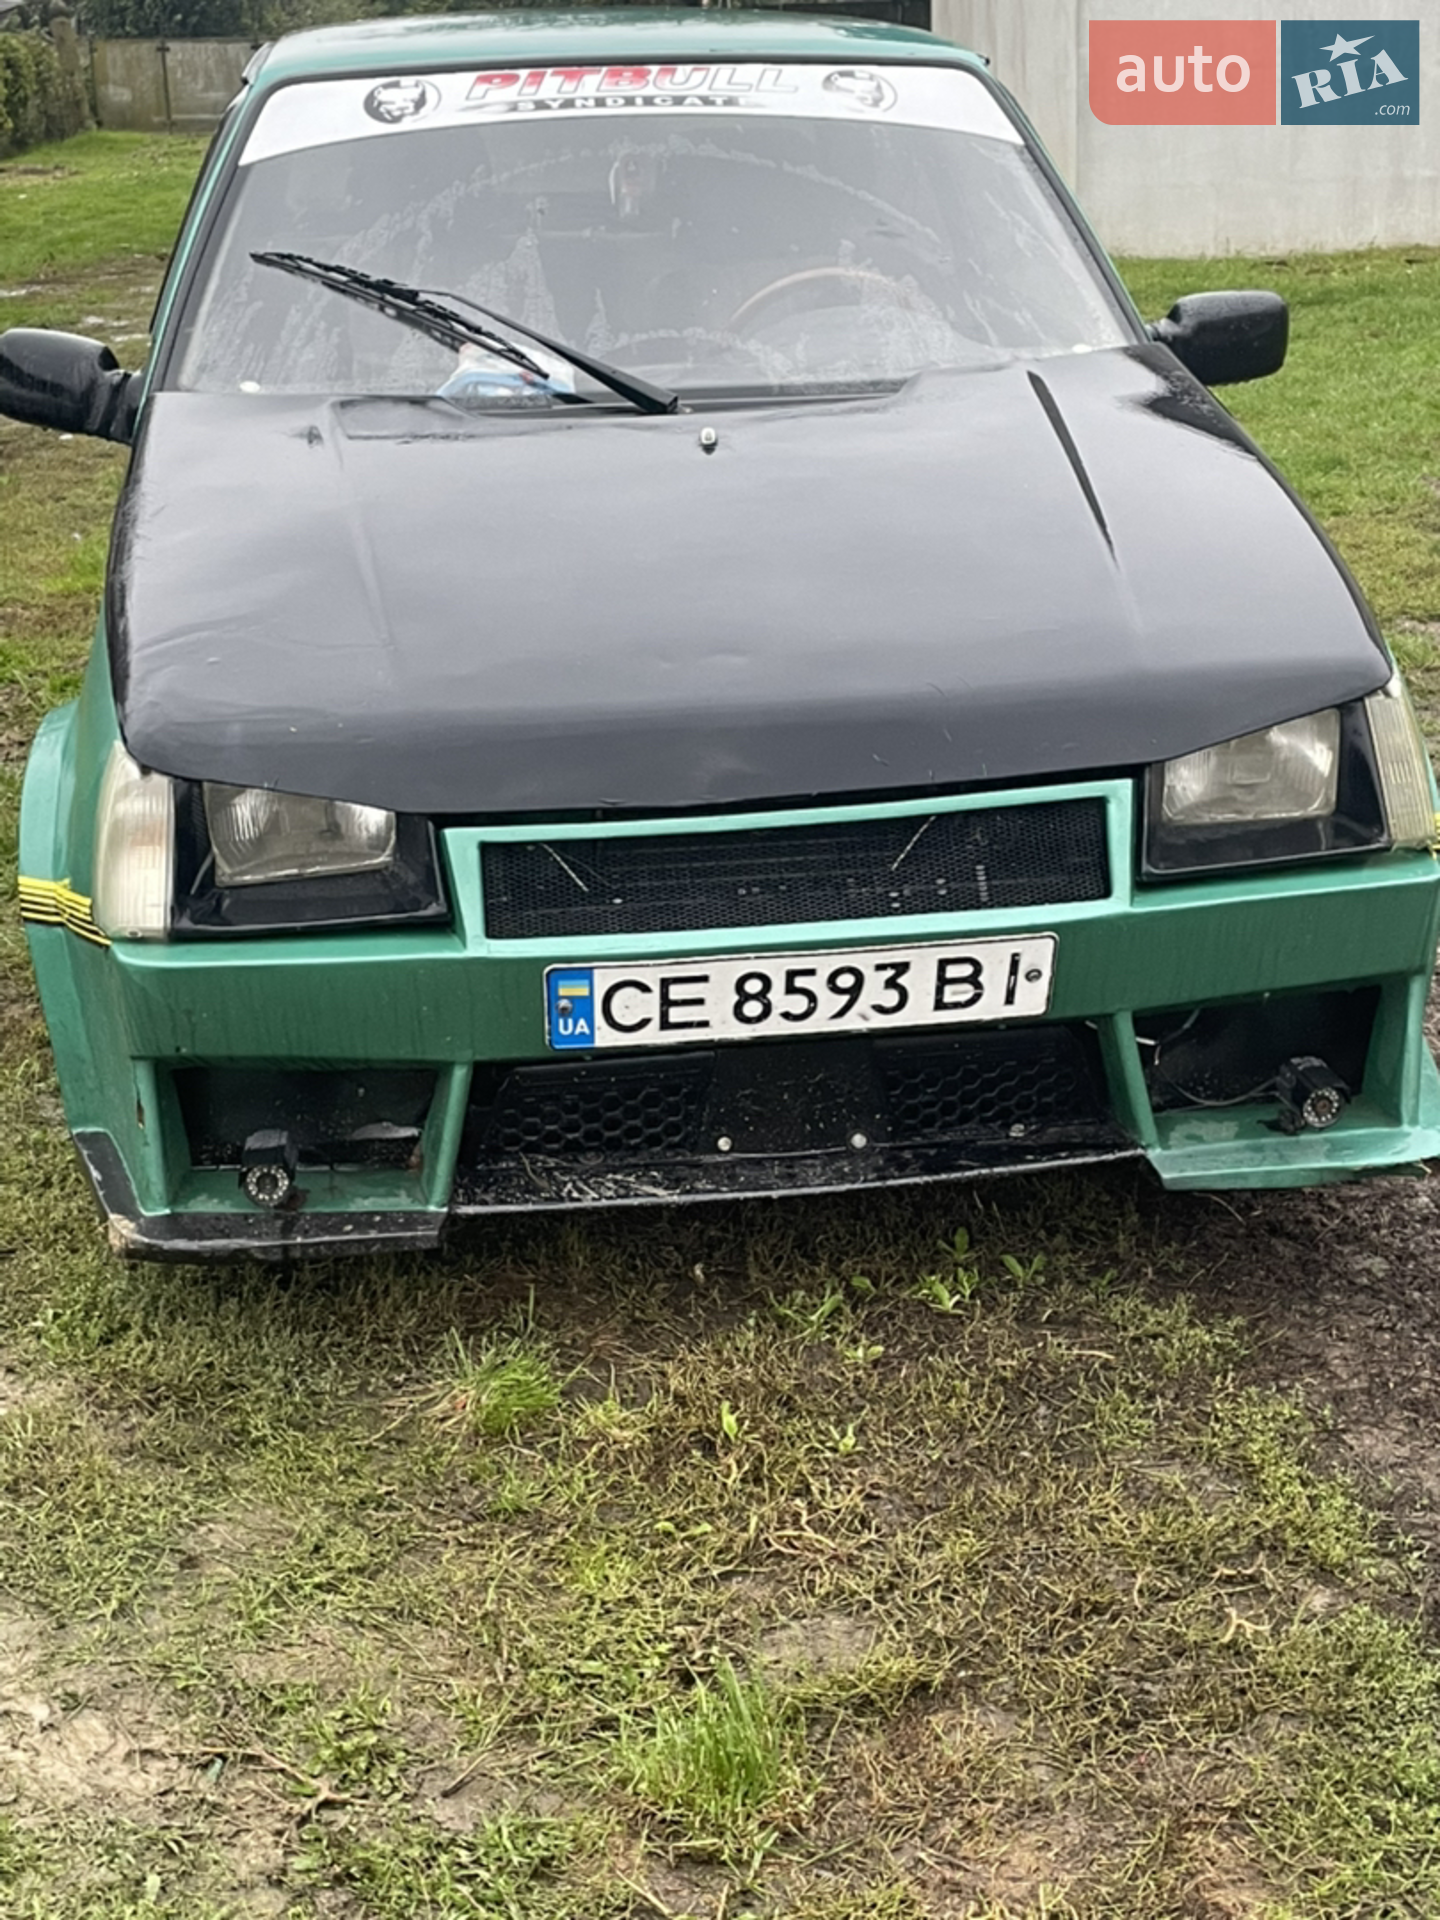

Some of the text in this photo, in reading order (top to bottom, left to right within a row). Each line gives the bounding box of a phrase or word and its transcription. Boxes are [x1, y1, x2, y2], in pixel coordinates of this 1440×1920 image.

[465, 66, 799, 101] PITBULL
[602, 974, 710, 1034] CE
[732, 961, 911, 1025] 8593
[558, 1017, 590, 1036] UA
